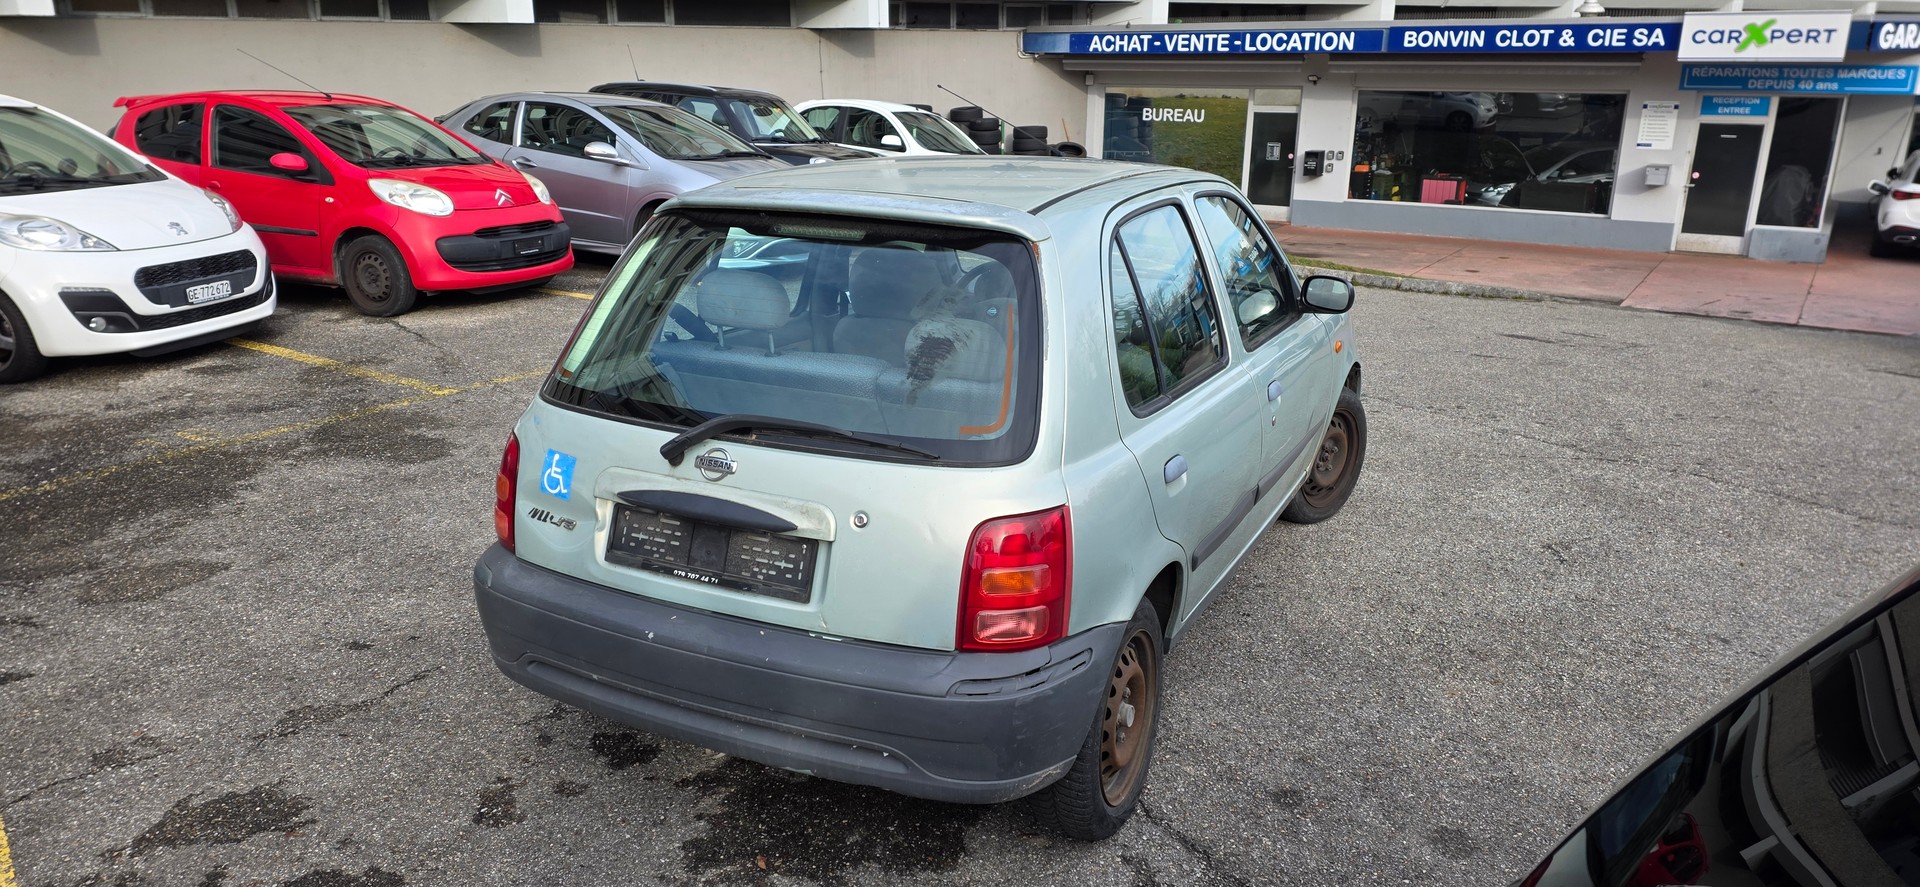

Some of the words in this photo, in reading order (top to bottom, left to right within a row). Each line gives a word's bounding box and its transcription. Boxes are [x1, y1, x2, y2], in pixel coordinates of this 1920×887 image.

[1088, 35, 1152, 52] ACHAT
[1164, 34, 1231, 52] VENTE
[1245, 32, 1355, 51] LOCATION
[1403, 30, 1485, 48] BONVIN
[1495, 29, 1554, 47] CLOT
[1558, 29, 1576, 47] &
[1587, 28, 1627, 47] CIE
[1632, 28, 1666, 47] SA
[1692, 66, 1780, 78] RÉPARATIONS
[1783, 68, 1834, 79] TOUTES
[1837, 68, 1906, 80] MARQUES
[1747, 79, 1795, 90] DEPUIS
[1798, 80, 1814, 91] 40
[1815, 81, 1839, 91] ans
[1712, 96, 1760, 105] RECEPTION
[1142, 107, 1205, 122] BUREAU
[1718, 106, 1751, 114] ENTREE
[698, 457, 732, 471] NISSAN
